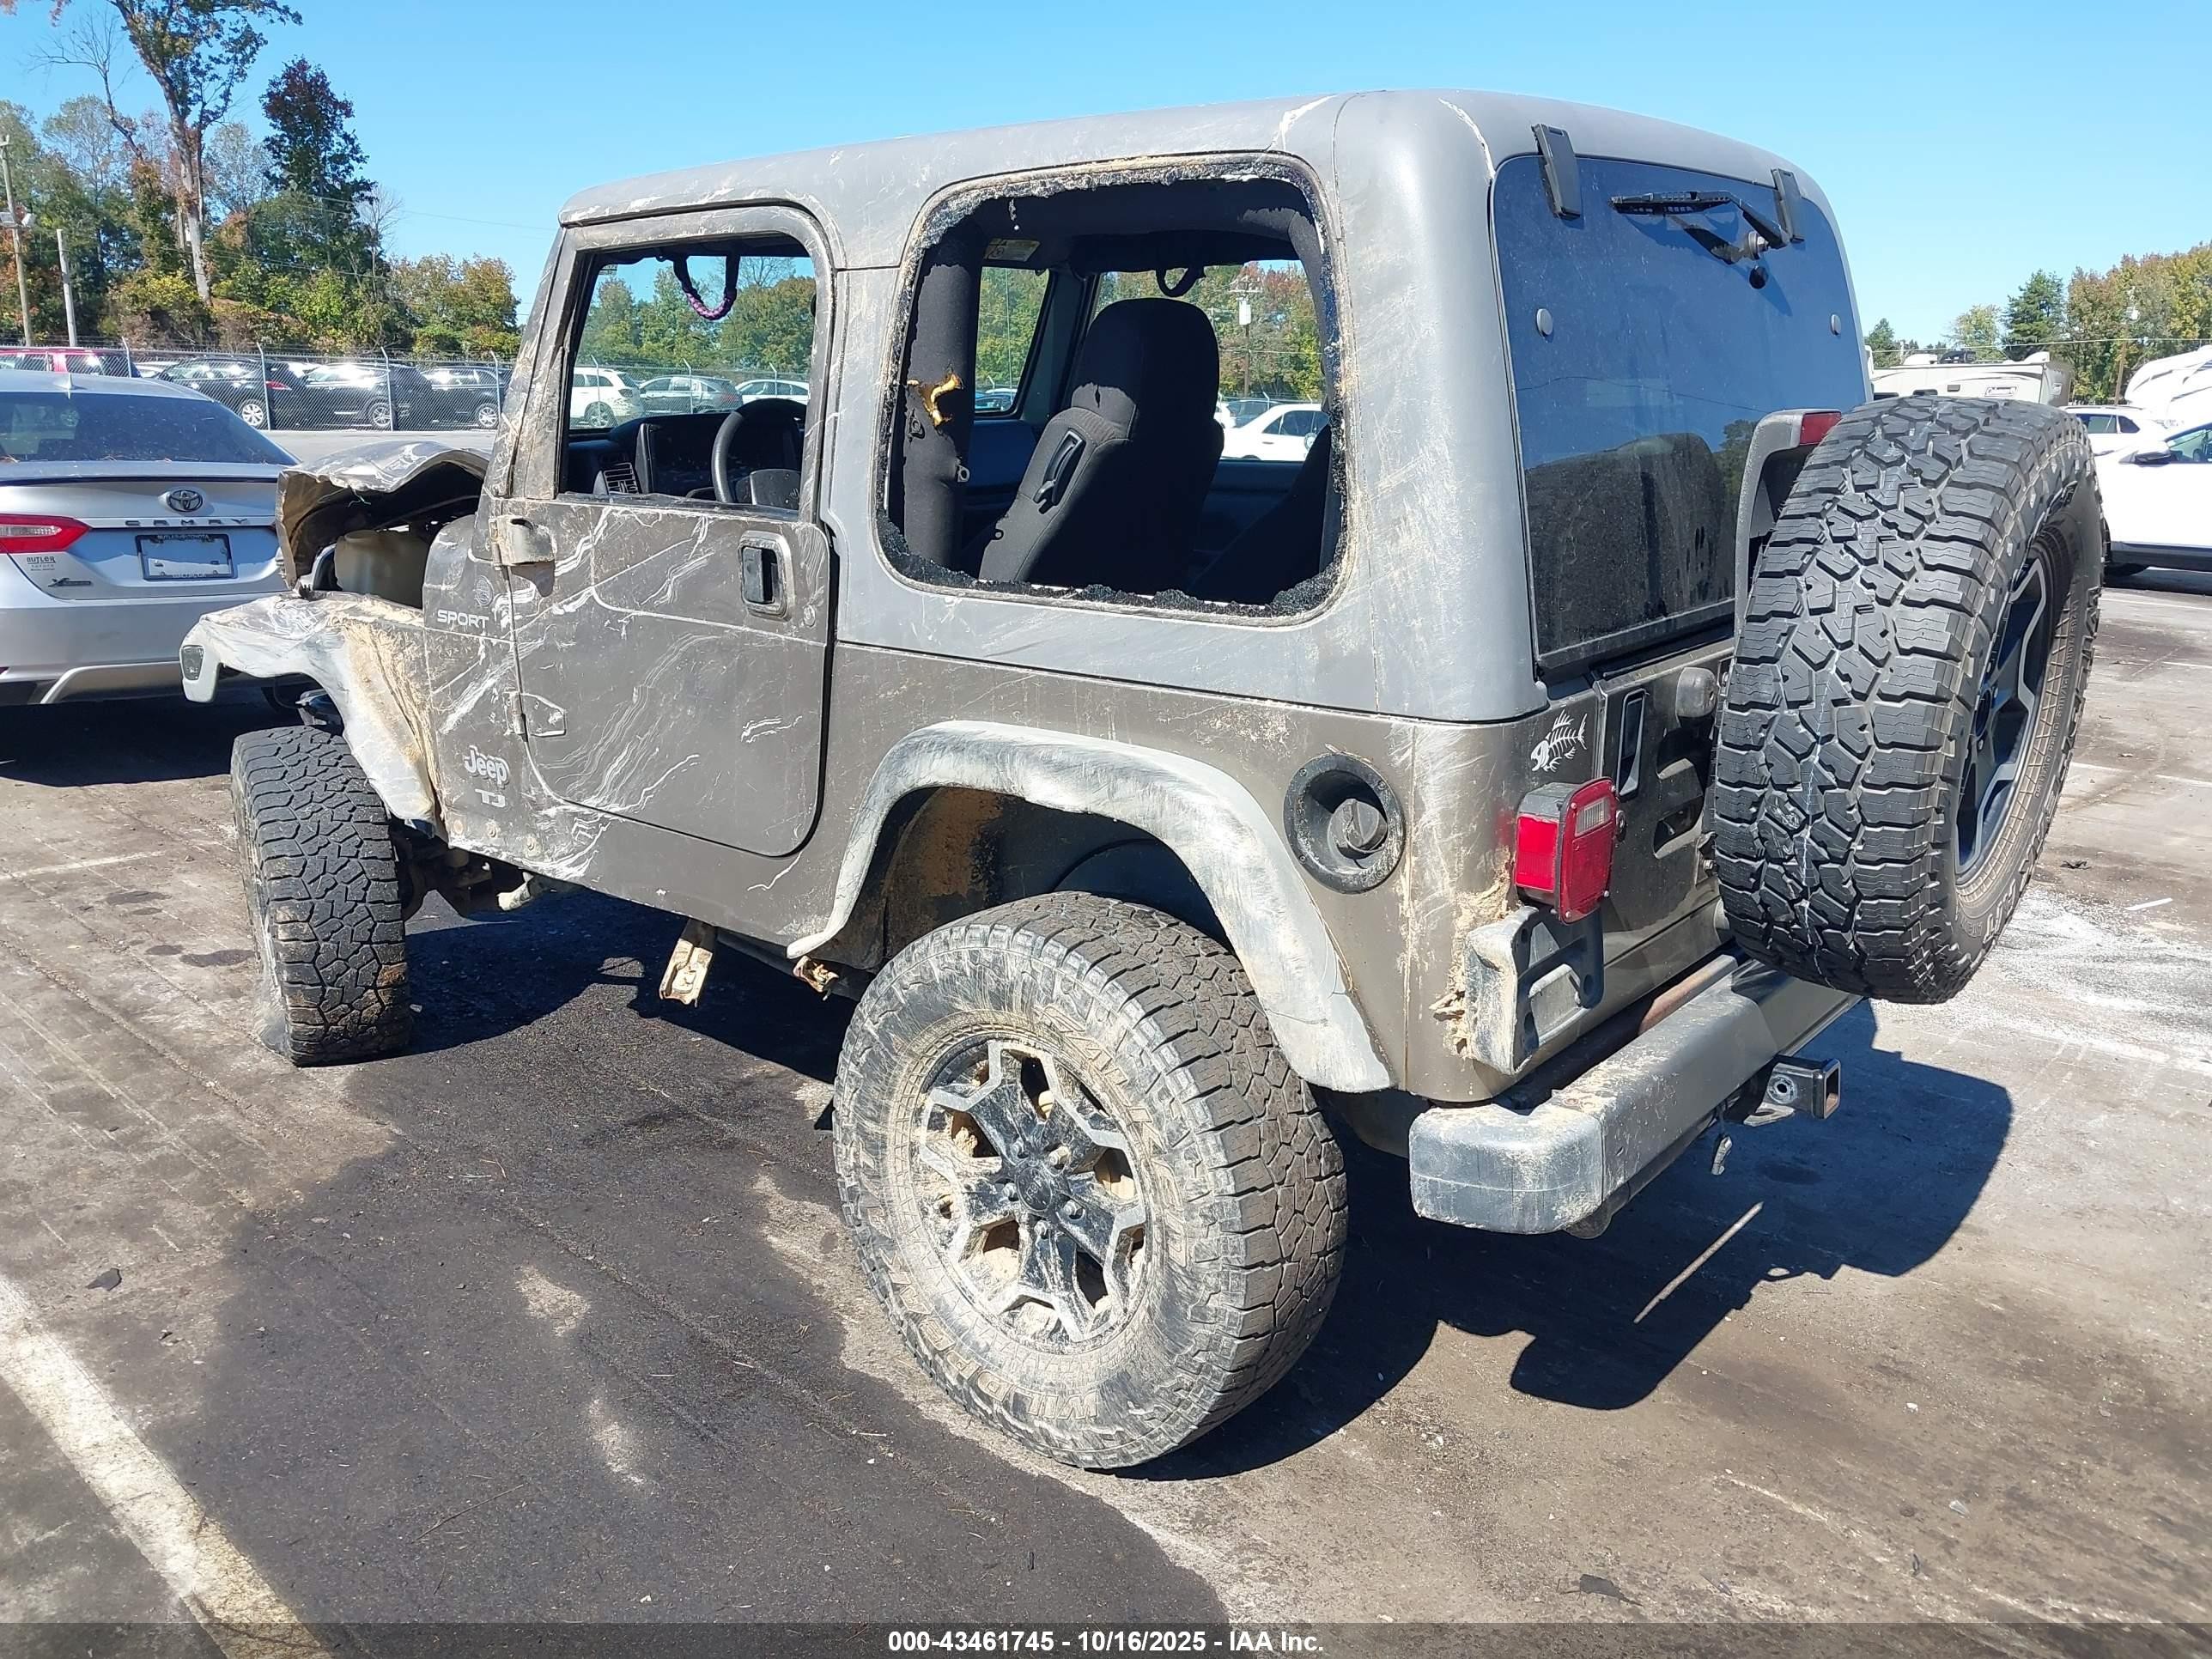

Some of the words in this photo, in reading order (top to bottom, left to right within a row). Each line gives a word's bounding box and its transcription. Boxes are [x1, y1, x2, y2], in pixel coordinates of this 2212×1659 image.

[125, 519, 247, 527] CAMRY
[437, 609, 489, 629] SPORT
[464, 747, 508, 786] Jeep
[475, 788, 506, 808] TJ
[879, 1247, 1098, 1419] WILDPEAK
